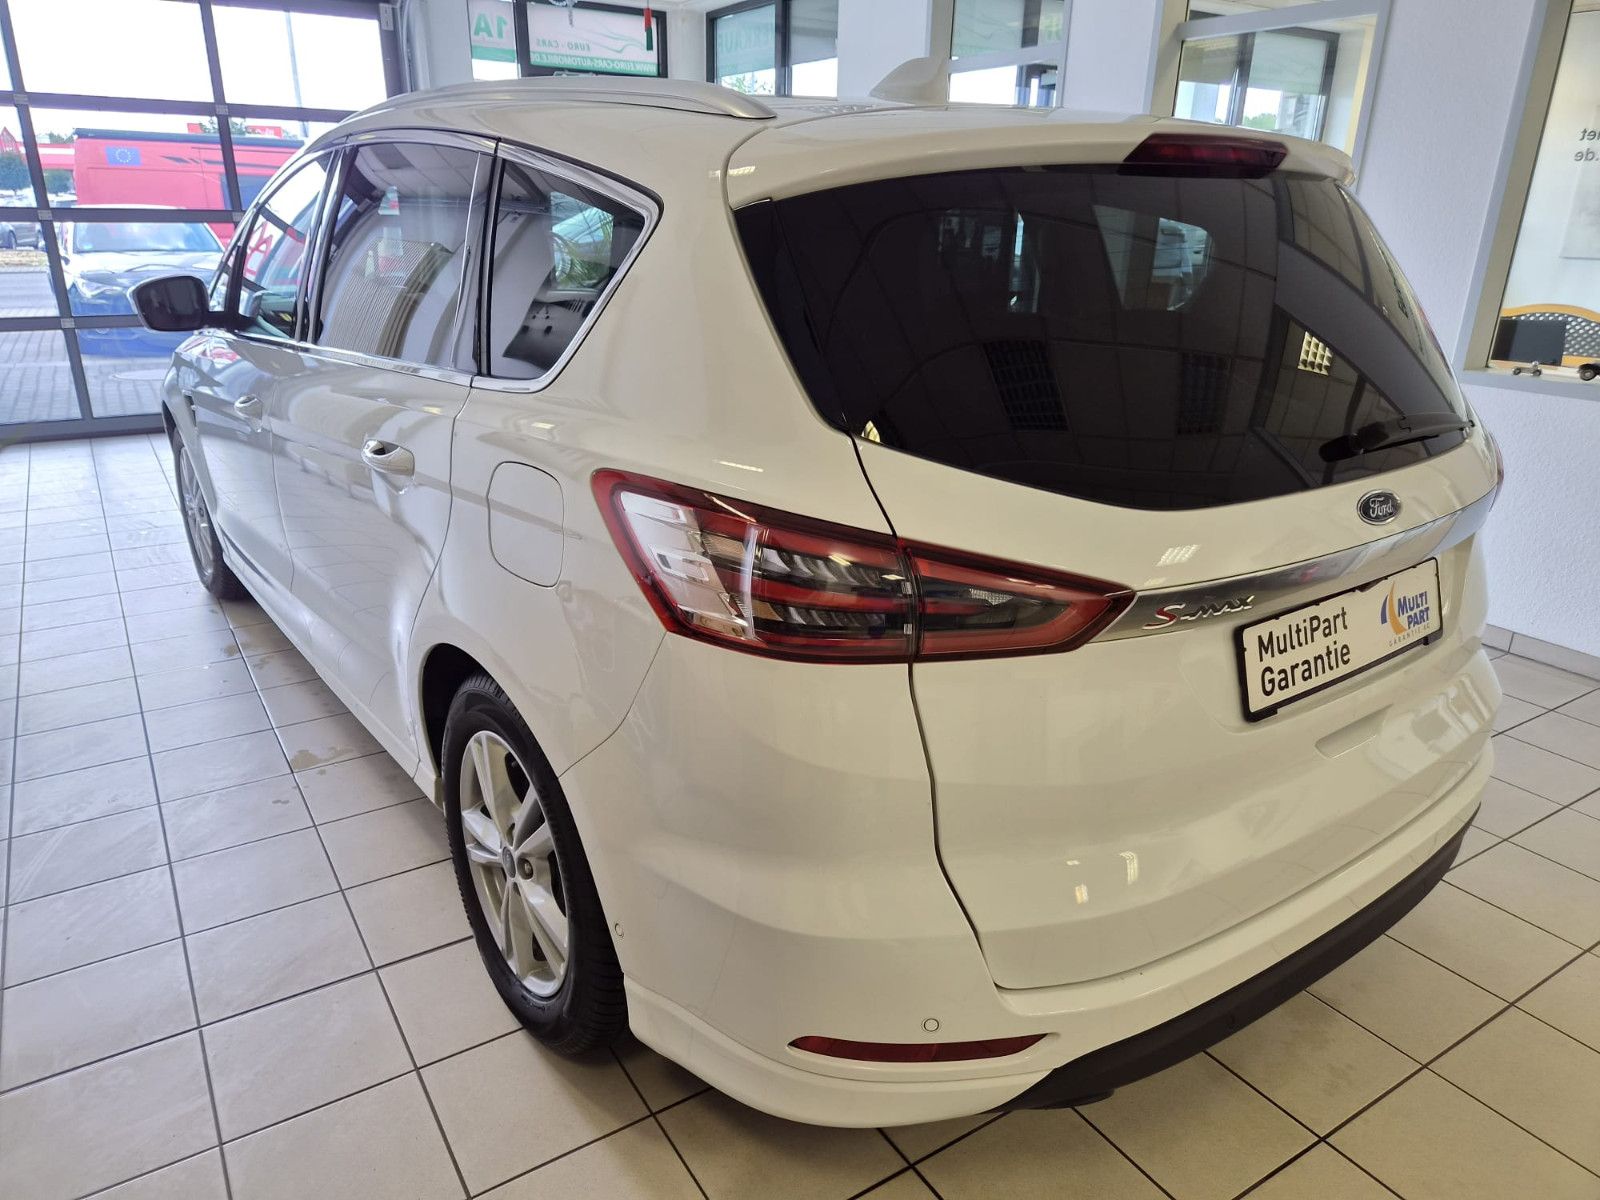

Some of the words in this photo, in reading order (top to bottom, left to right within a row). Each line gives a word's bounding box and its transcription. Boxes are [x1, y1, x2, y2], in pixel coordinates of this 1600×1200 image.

[1369, 496, 1394, 518] Ford
[1397, 591, 1428, 618] MULTI
[1406, 606, 1430, 630] PART
[1257, 606, 1348, 662] MultiPart
[1260, 641, 1351, 697] Garantie
